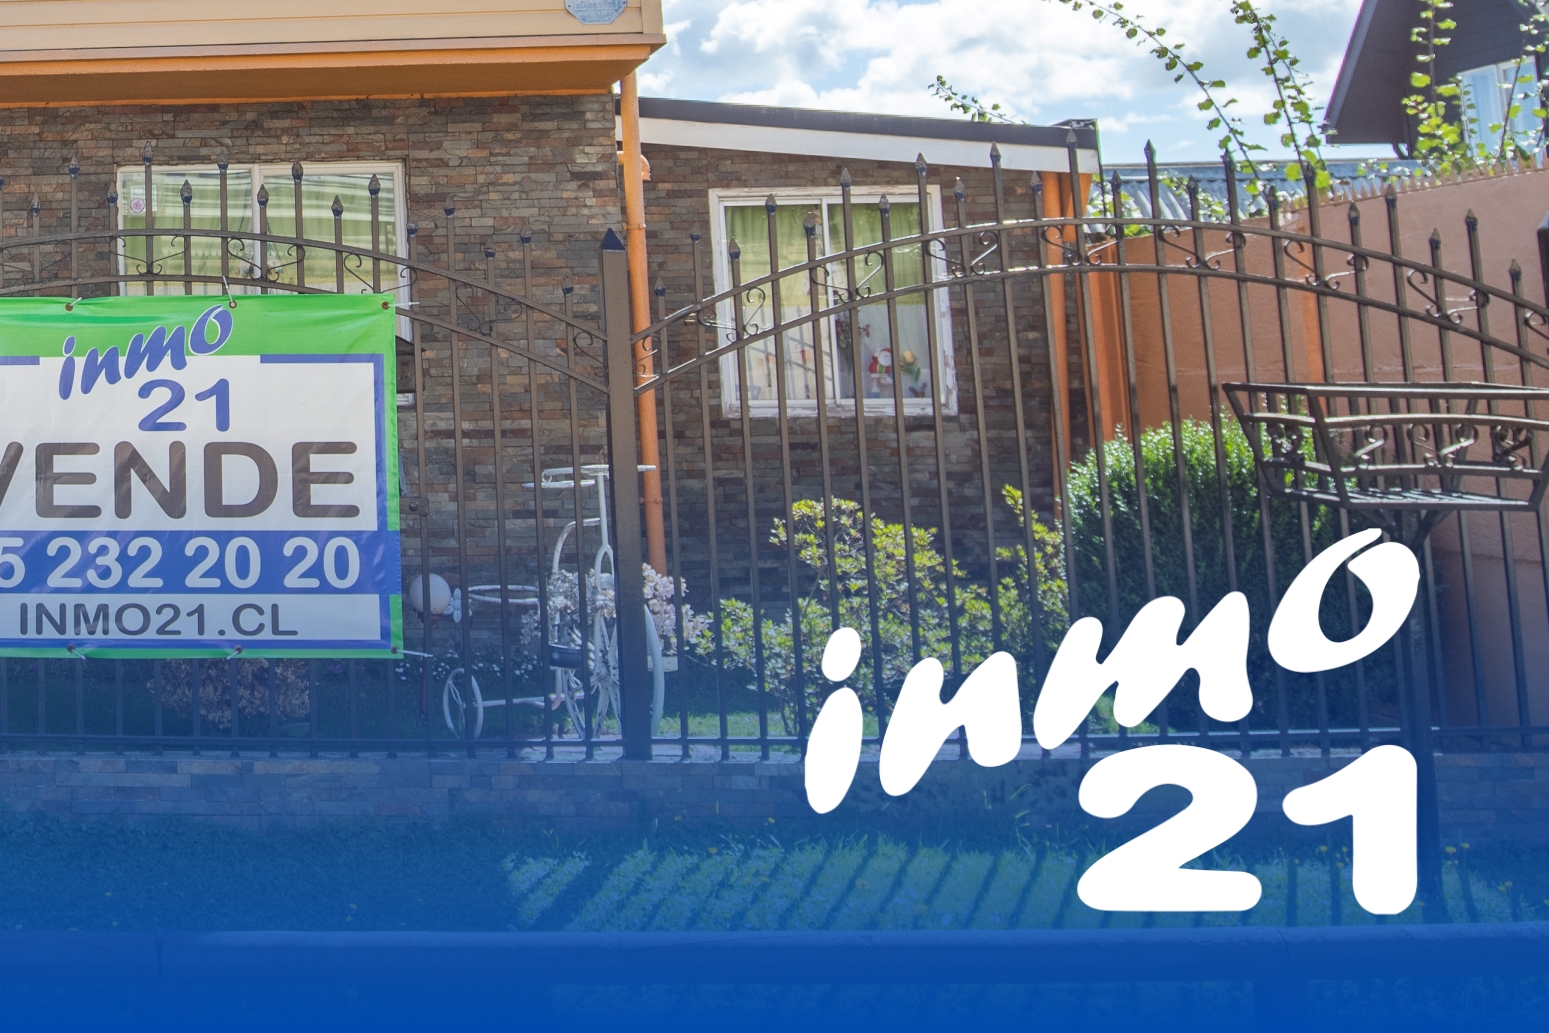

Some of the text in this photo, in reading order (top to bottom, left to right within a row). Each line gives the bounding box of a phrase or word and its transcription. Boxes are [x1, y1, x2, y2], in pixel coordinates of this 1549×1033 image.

[58, 304, 234, 400] inmo
[137, 378, 230, 432] 21
[46, 536, 164, 589] 232
[184, 536, 262, 589] 20
[282, 536, 360, 589] 20
[19, 602, 299, 637] INMO21.CL
